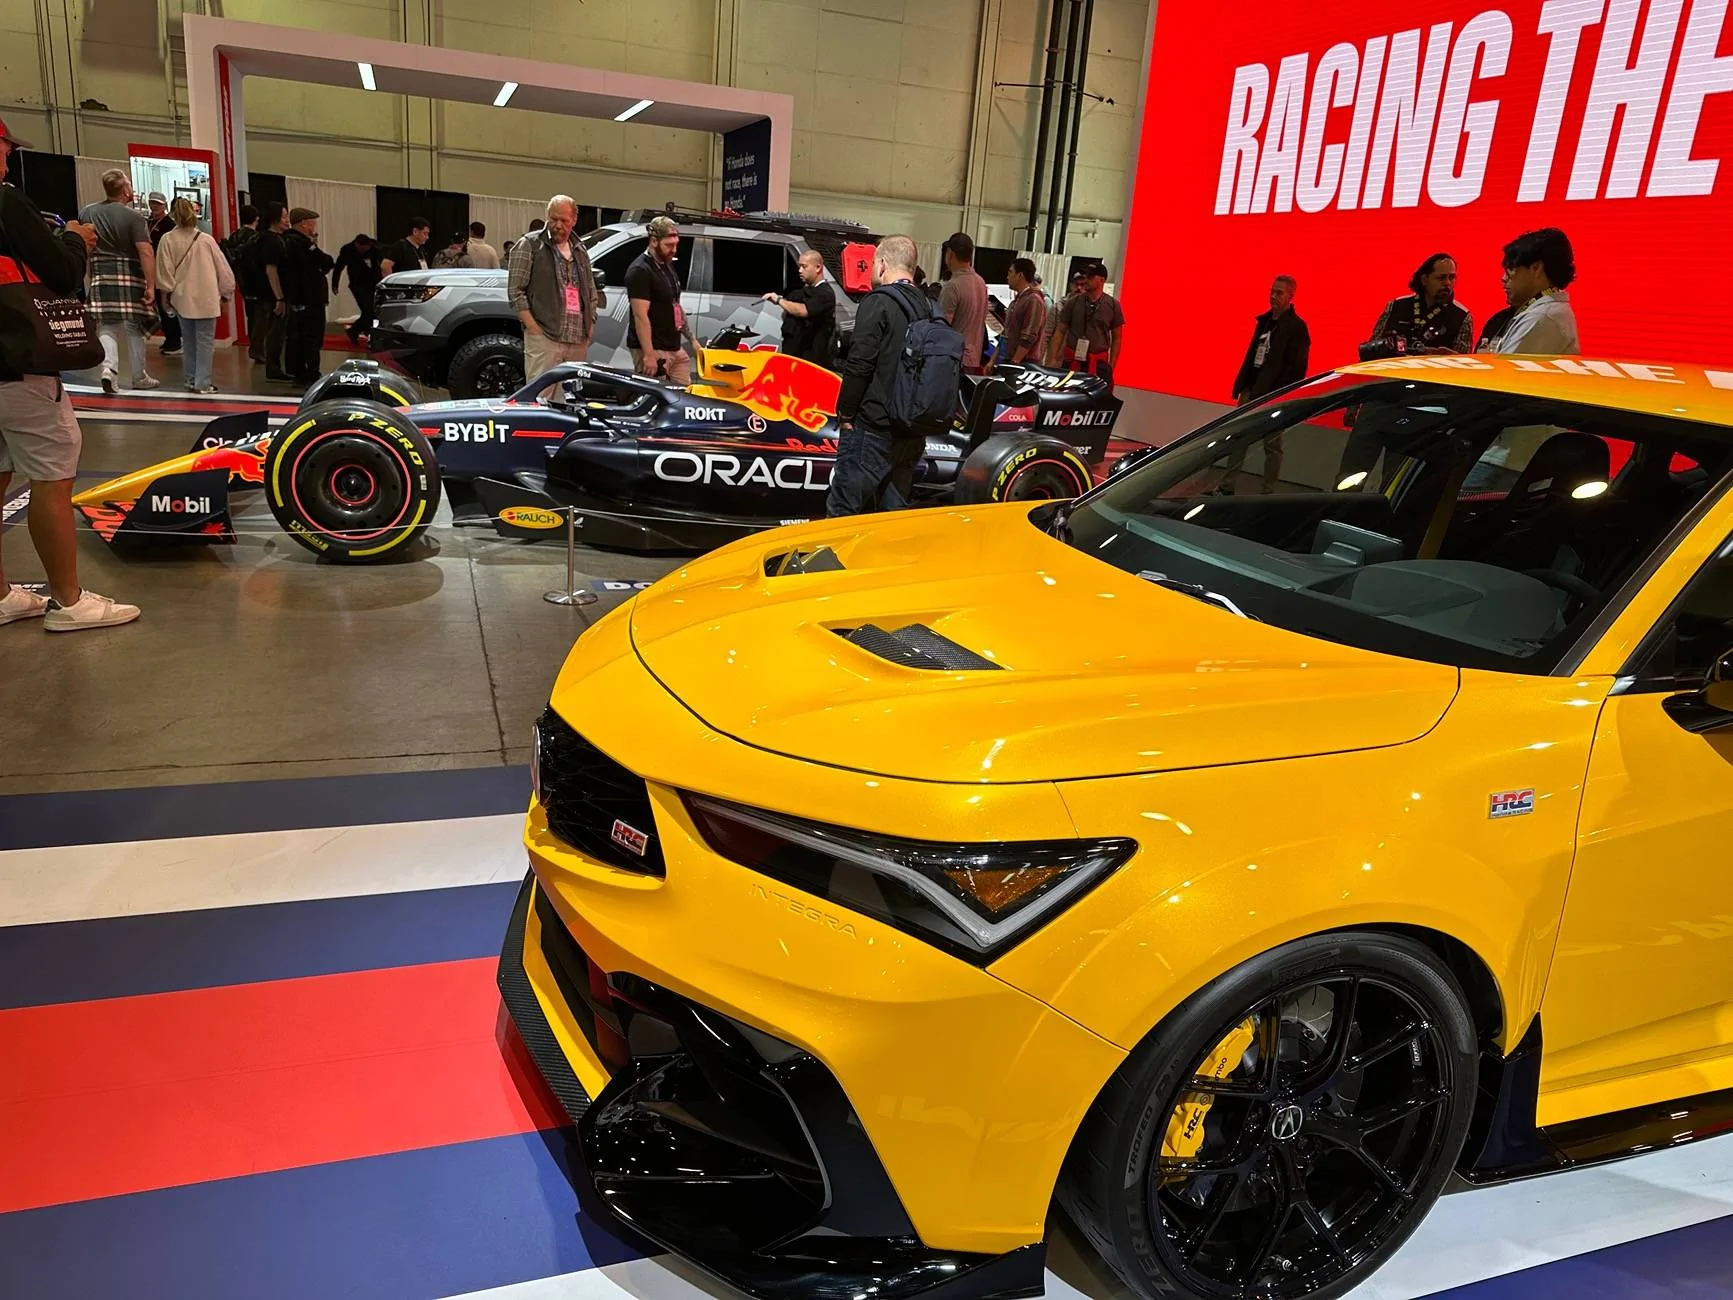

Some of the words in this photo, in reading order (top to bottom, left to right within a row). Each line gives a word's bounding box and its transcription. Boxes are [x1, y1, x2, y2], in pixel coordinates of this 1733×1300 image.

[1214, 10, 1513, 215] RACING
[1516, 0, 1733, 203] THE
[1509, 359, 1686, 385] THE
[684, 406, 726, 421] ROKT
[1043, 410, 1095, 427] Mobil
[348, 411, 366, 421] P
[369, 417, 424, 466] ZERO
[444, 420, 510, 443] BYBIT
[925, 443, 958, 452] ONDA
[654, 452, 836, 491] ORACL
[997, 447, 1037, 487] ZERO
[151, 495, 211, 514] Mobil
[517, 511, 556, 524] RAUCH
[1491, 790, 1533, 812] HRC
[748, 883, 857, 940] INTEGRA
[1184, 1107, 1203, 1140] HRC
[1128, 1104, 1154, 1174] TROFEO
